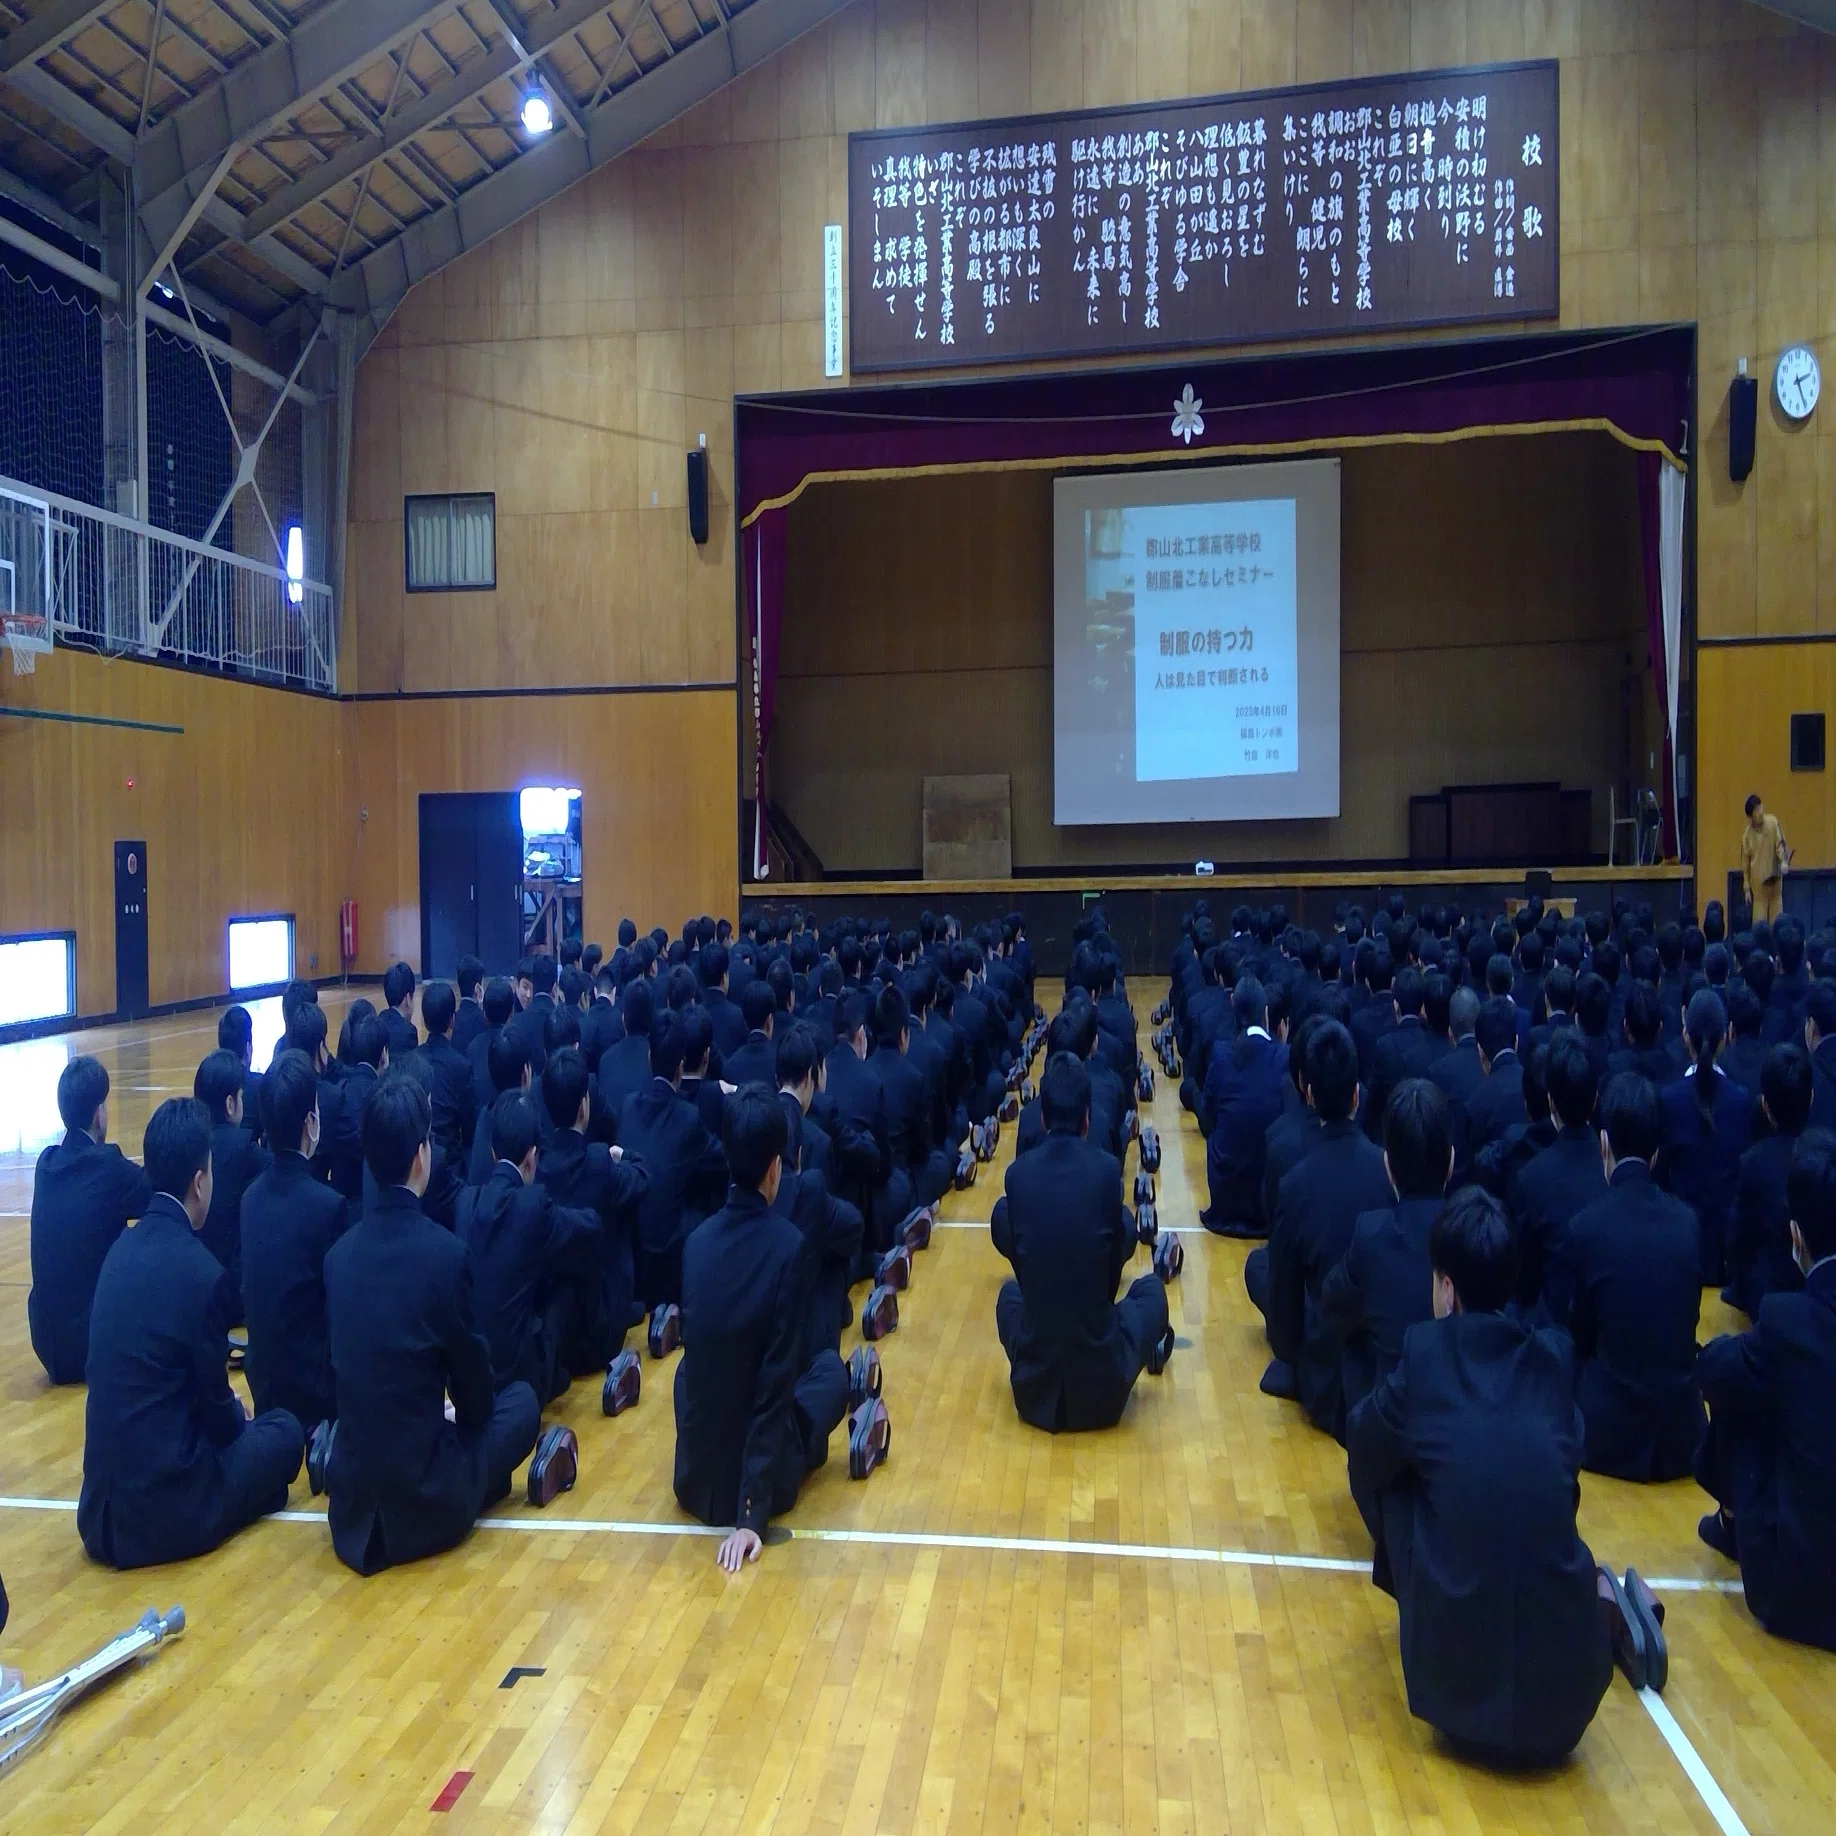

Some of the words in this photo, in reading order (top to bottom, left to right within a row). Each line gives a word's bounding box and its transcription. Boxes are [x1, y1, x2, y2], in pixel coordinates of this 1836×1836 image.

[1311, 112, 1327, 167] 我等
[1344, 111, 1356, 161] おお
[1373, 109, 1386, 187] これぞ
[1437, 97, 1453, 125] 今
[883, 155, 898, 208] 真理
[899, 154, 912, 208] 我等
[927, 158, 939, 204] いざ
[954, 153, 967, 229] これぞ
[1042, 141, 1057, 219] 残雪の
[1086, 137, 1101, 215] 永遠に
[1101, 135, 1116, 189] 我等
[1132, 133, 1144, 185] ああ
[1160, 133, 1172, 209] これぞ
[1189, 130, 1204, 262] 八山田が丘
[1236, 120, 1252, 257] 飯豊の星を
[1253, 117, 1267, 255] 暮れなずむ
[1283, 114, 1297, 226] 集いけり
[1298, 117, 1309, 195] ここに
[1387, 104, 1403, 244] 白亜の母校
[1404, 102, 1420, 241] 朝日に輝く
[1438, 154, 1453, 239] 時到り
[1455, 96, 1471, 265] 安積の沃野に
[1472, 95, 1487, 235] 明け初むる
[871, 162, 884, 289] いそしまん
[913, 153, 928, 340] 特色を発揮せん
[967, 147, 983, 281] 学びの高殿
[982, 148, 997, 334] 不抜の根を張る
[997, 145, 1012, 306] 拡がる都市に
[1012, 144, 1026, 278] 想いも深く
[1026, 142, 1042, 304] 安達太良山に
[1101, 217, 1117, 271] 駿馬
[1117, 133, 1133, 323] 創造の意気高し
[1144, 131, 1160, 329] 郡山北工業高等学校
[1173, 129, 1189, 292] そびゆる学舎
[1220, 123, 1235, 288] 低く見おろし
[1311, 196, 1327, 250] 健児
[1328, 110, 1344, 304] 調和の旗のもと
[1356, 107, 1372, 310] 郡山北工業高等学校
[884, 236, 898, 314] 求めて
[899, 236, 913, 288] 学徒
[939, 151, 955, 345] 郡山北工業高等学校
[1086, 246, 1101, 326] 未来に
[1297, 226, 1309, 307] 朗らに
[1146, 532, 1262, 558] 郡山北工業高等学校
[1146, 565, 1274, 591] 制服着こなしセミナー
[1160, 625, 1253, 656] 制服の持つ力
